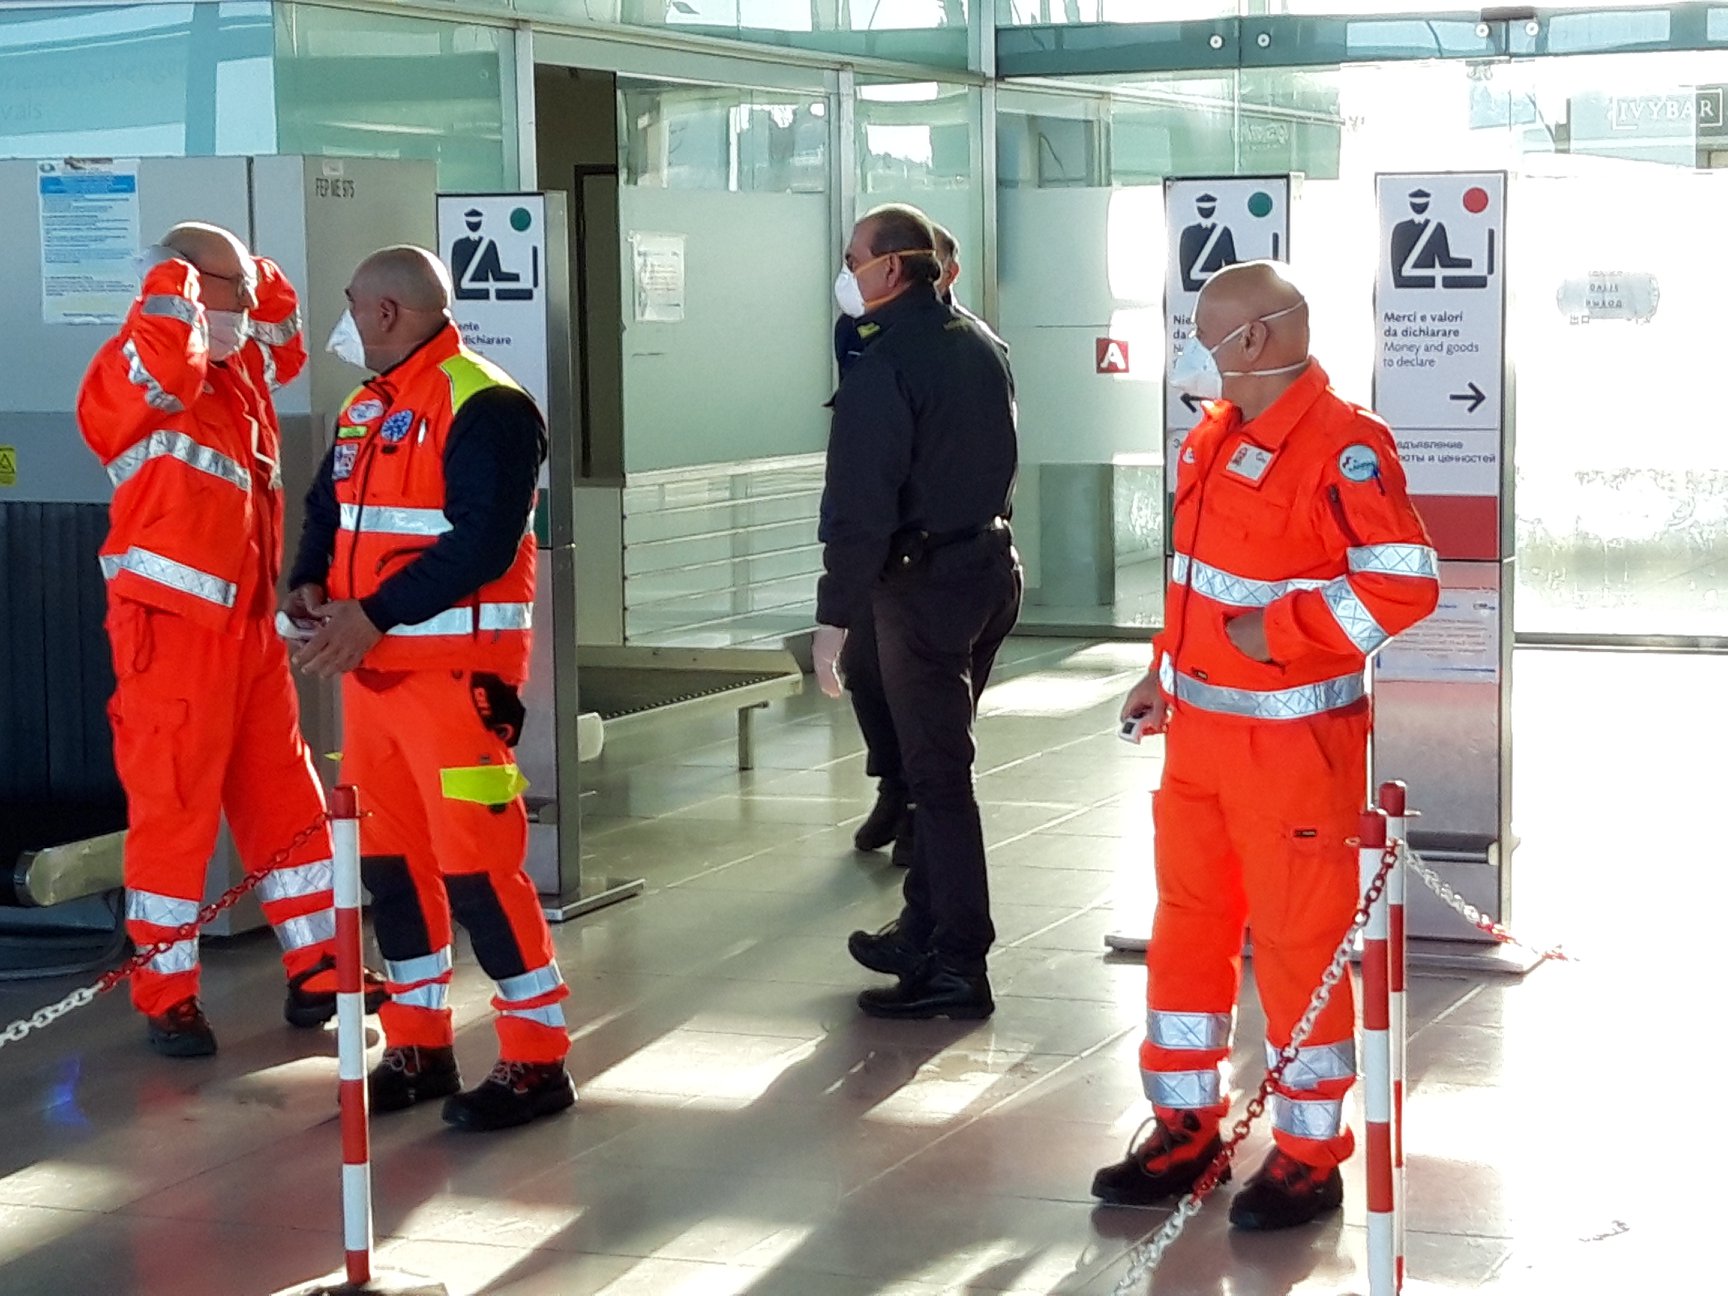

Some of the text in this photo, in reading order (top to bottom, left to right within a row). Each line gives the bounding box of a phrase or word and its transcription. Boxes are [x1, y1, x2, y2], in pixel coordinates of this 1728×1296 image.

[1383, 311, 1464, 323] Merci e valori
[1173, 328, 1187, 340] da
[1383, 326, 1460, 338] da dichiarare
[1383, 341, 1480, 356] Money and goods
[1099, 342, 1127, 370] A
[1383, 356, 1436, 368] to declare
[1427, 454, 1436, 463] и
[1437, 452, 1497, 465] ценностей
